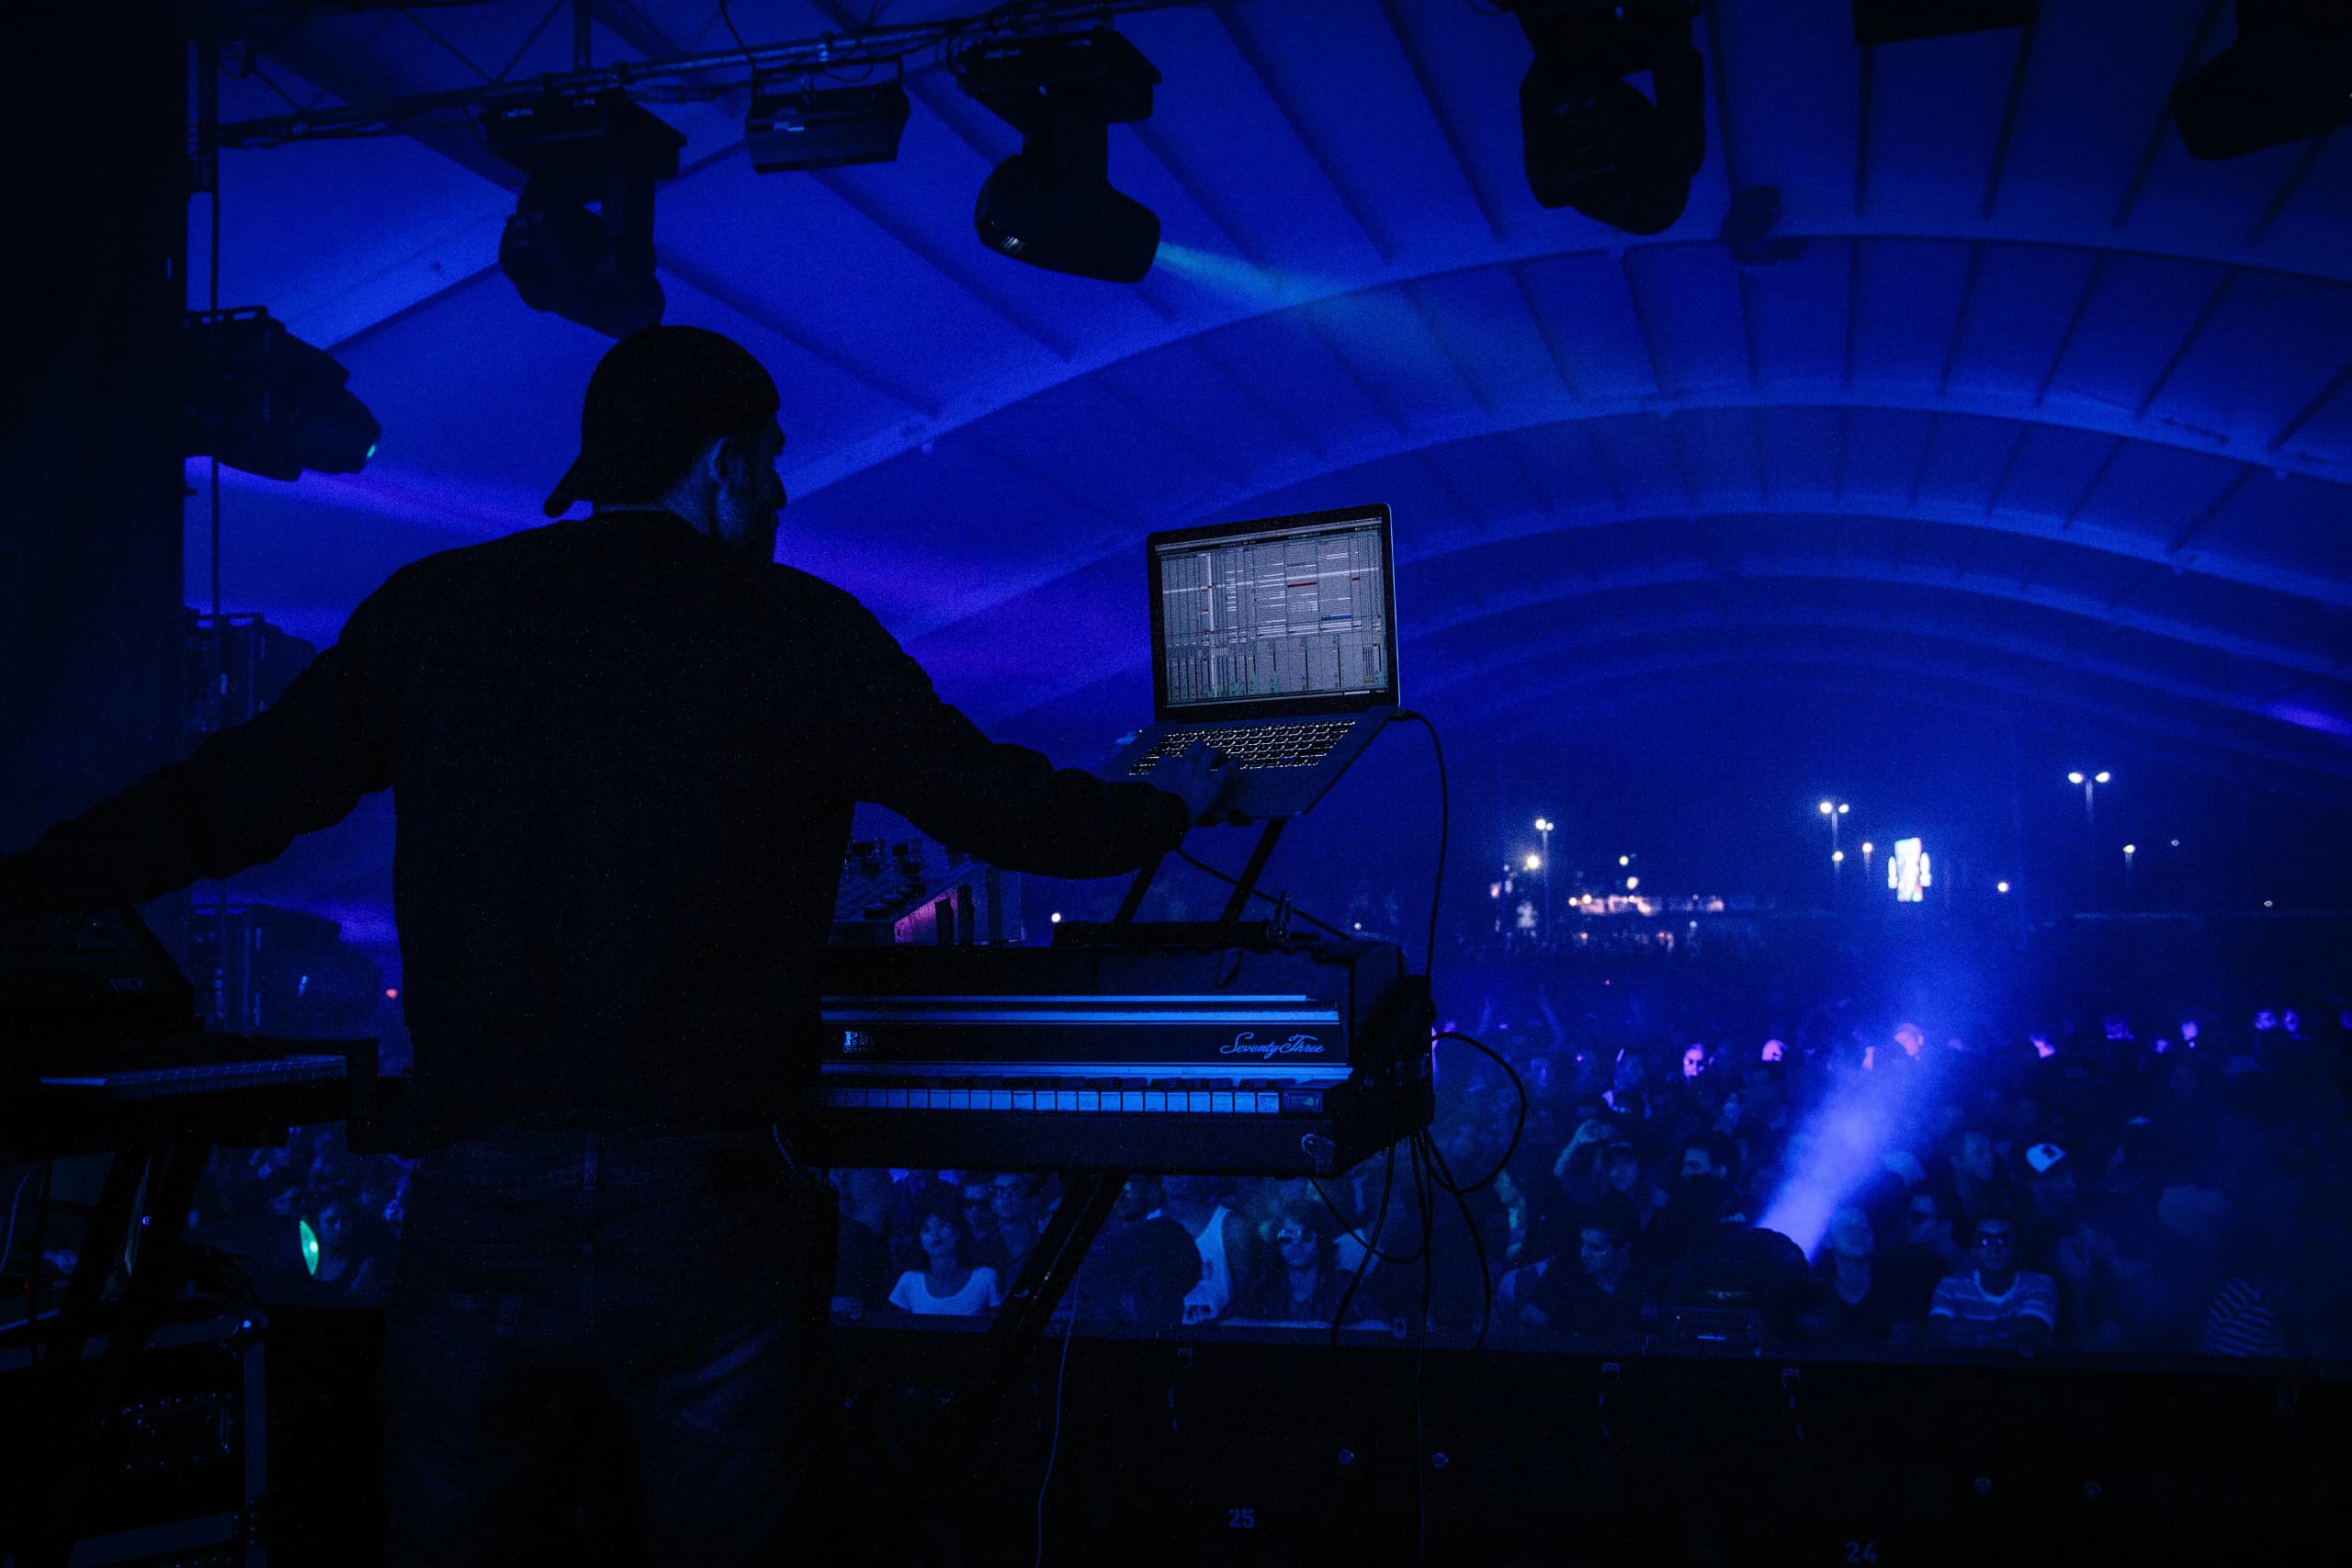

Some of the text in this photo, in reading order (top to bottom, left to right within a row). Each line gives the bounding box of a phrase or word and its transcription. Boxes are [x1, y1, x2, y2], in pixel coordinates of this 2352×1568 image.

[1220, 1032, 1324, 1059] Seventy Three
[1227, 1506, 1256, 1529] 25
[1845, 1540, 1877, 1564] 24
